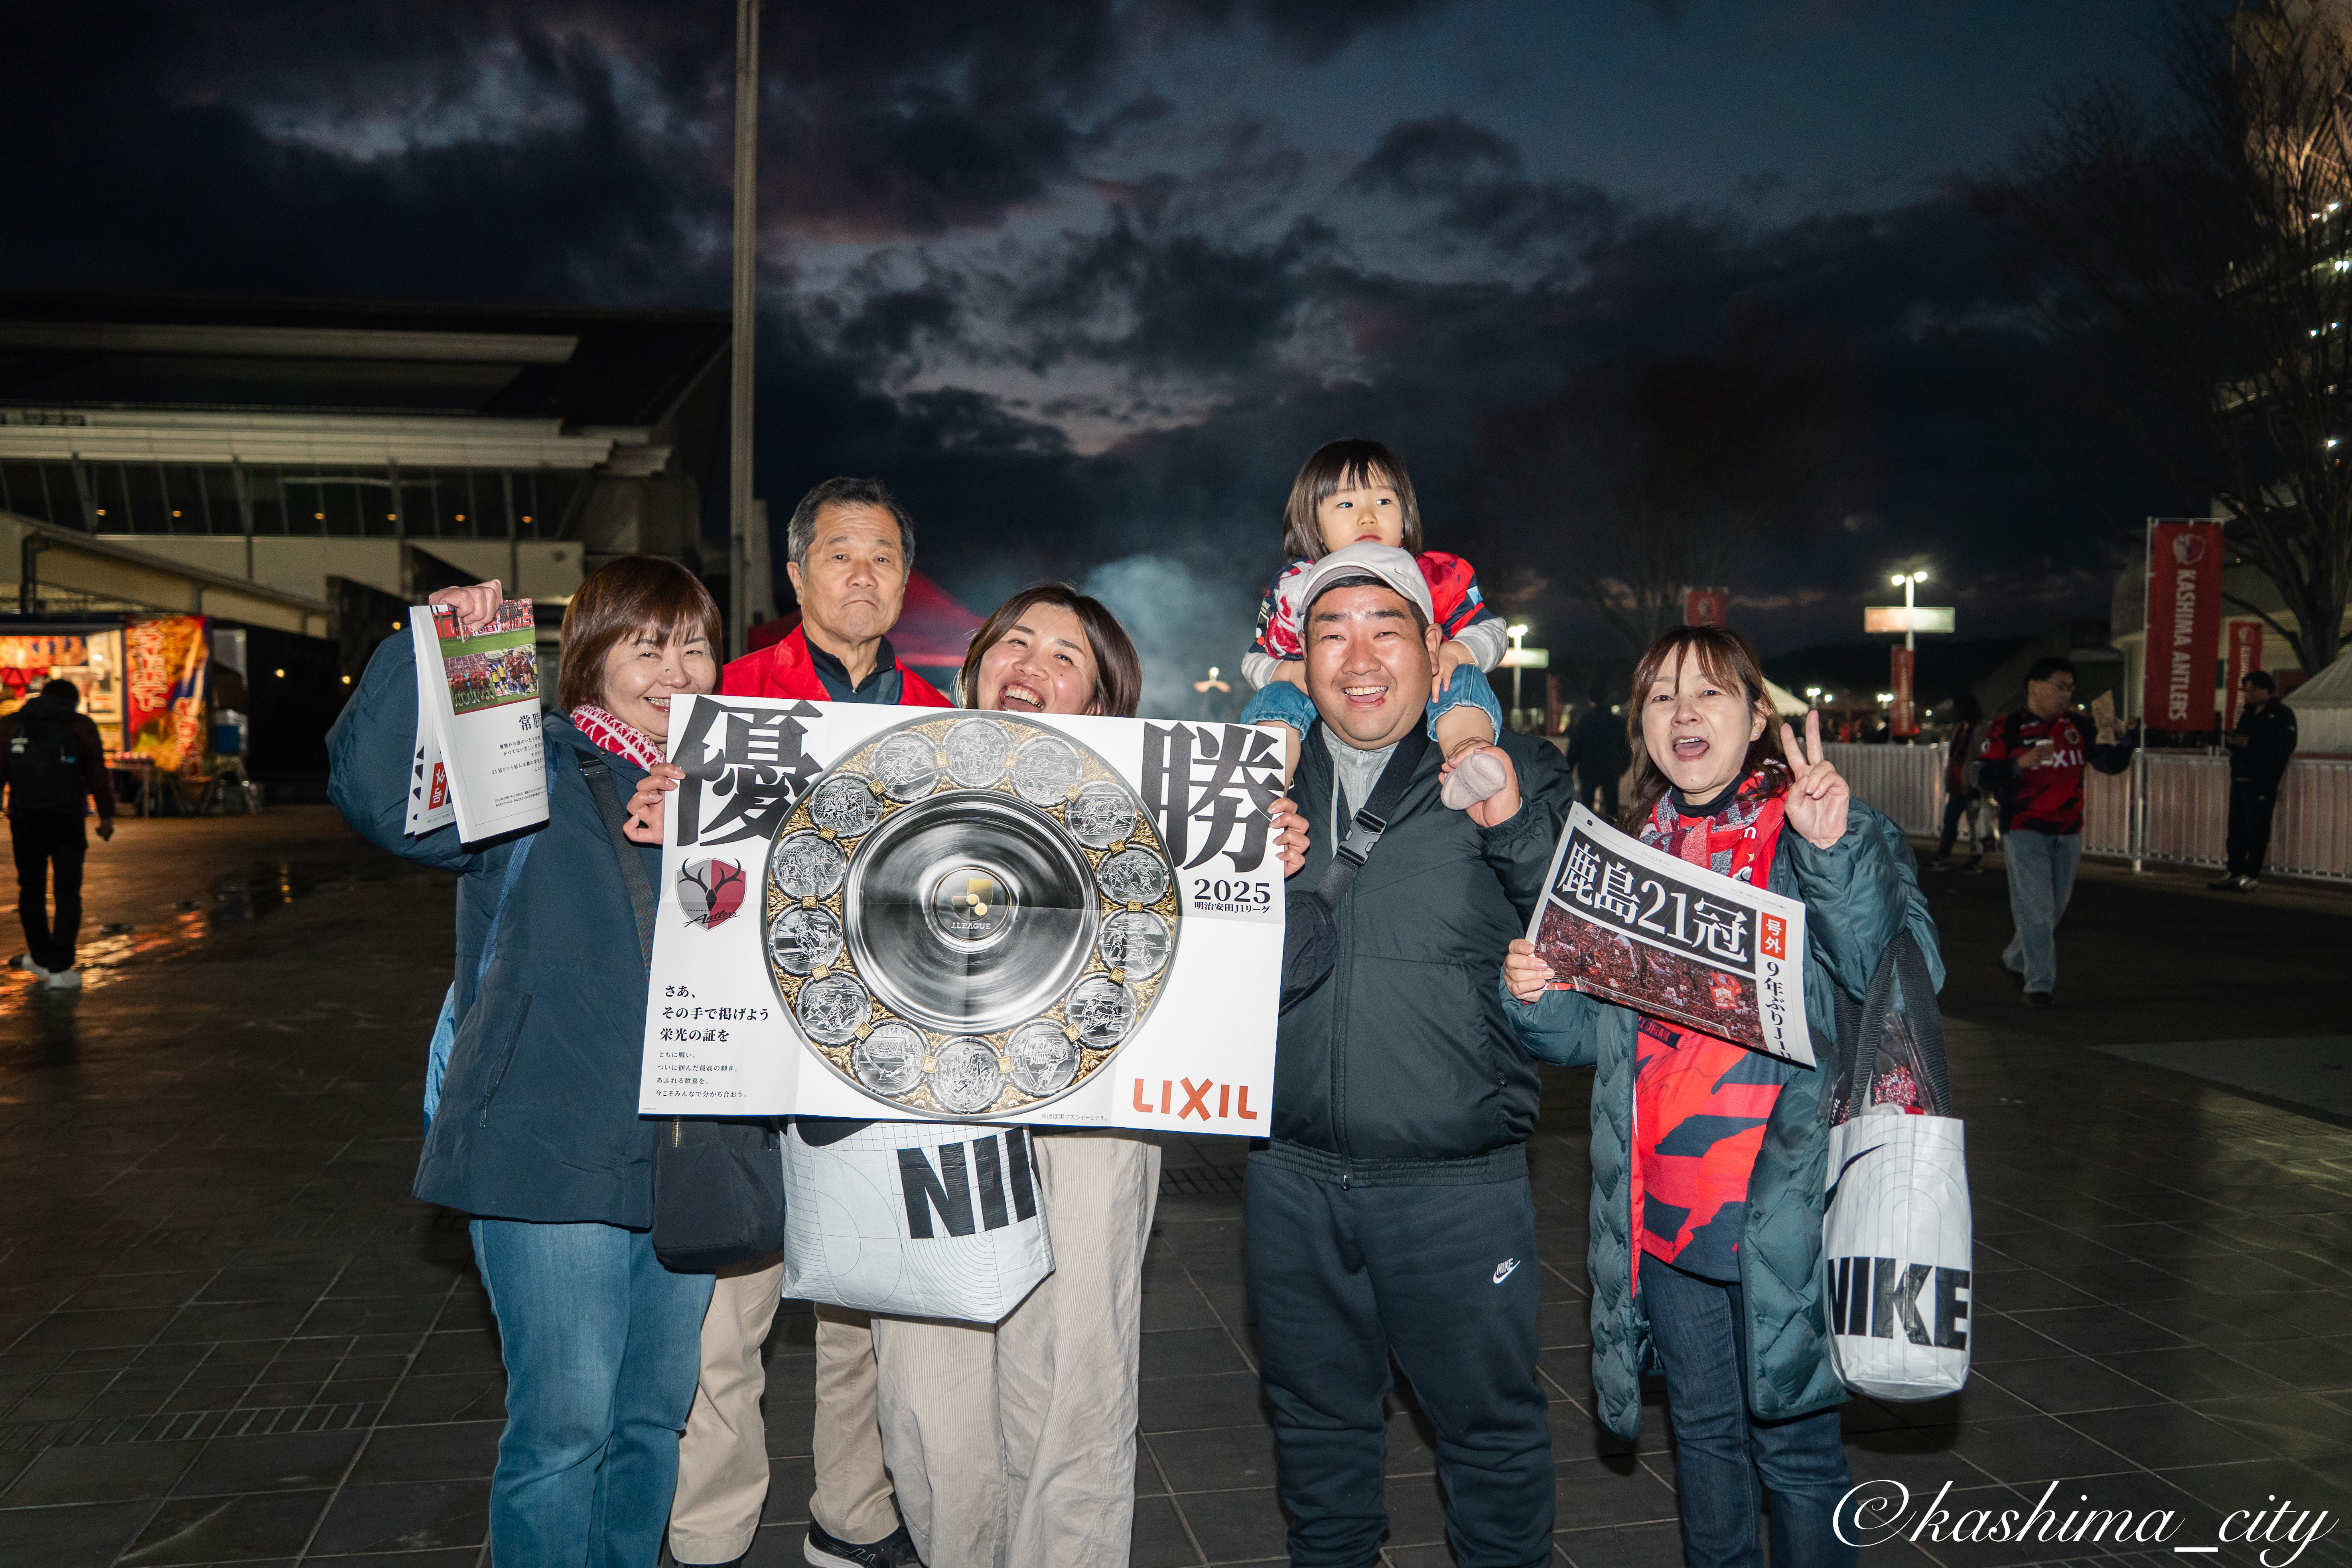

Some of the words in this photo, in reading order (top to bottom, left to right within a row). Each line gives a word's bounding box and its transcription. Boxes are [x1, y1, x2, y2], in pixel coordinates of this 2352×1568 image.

[2174, 569, 2196, 647] KASHIMA
[2168, 650, 2191, 721] ANTLERS
[1140, 722, 1285, 873] 勝
[1194, 879, 1271, 904] 2025
[1557, 840, 1749, 962] 鹿島21冠
[683, 910, 740, 927] Antlers
[1194, 901, 1270, 914] 明治安田J1リーグ
[1765, 919, 1782, 954] 号外
[665, 985, 695, 998] さあ、
[662, 1007, 768, 1020] その手で掲げよう
[659, 1028, 729, 1042] 栄光の証を
[1133, 1077, 1257, 1120] LIXIL
[1496, 1258, 1514, 1275] NIKE
